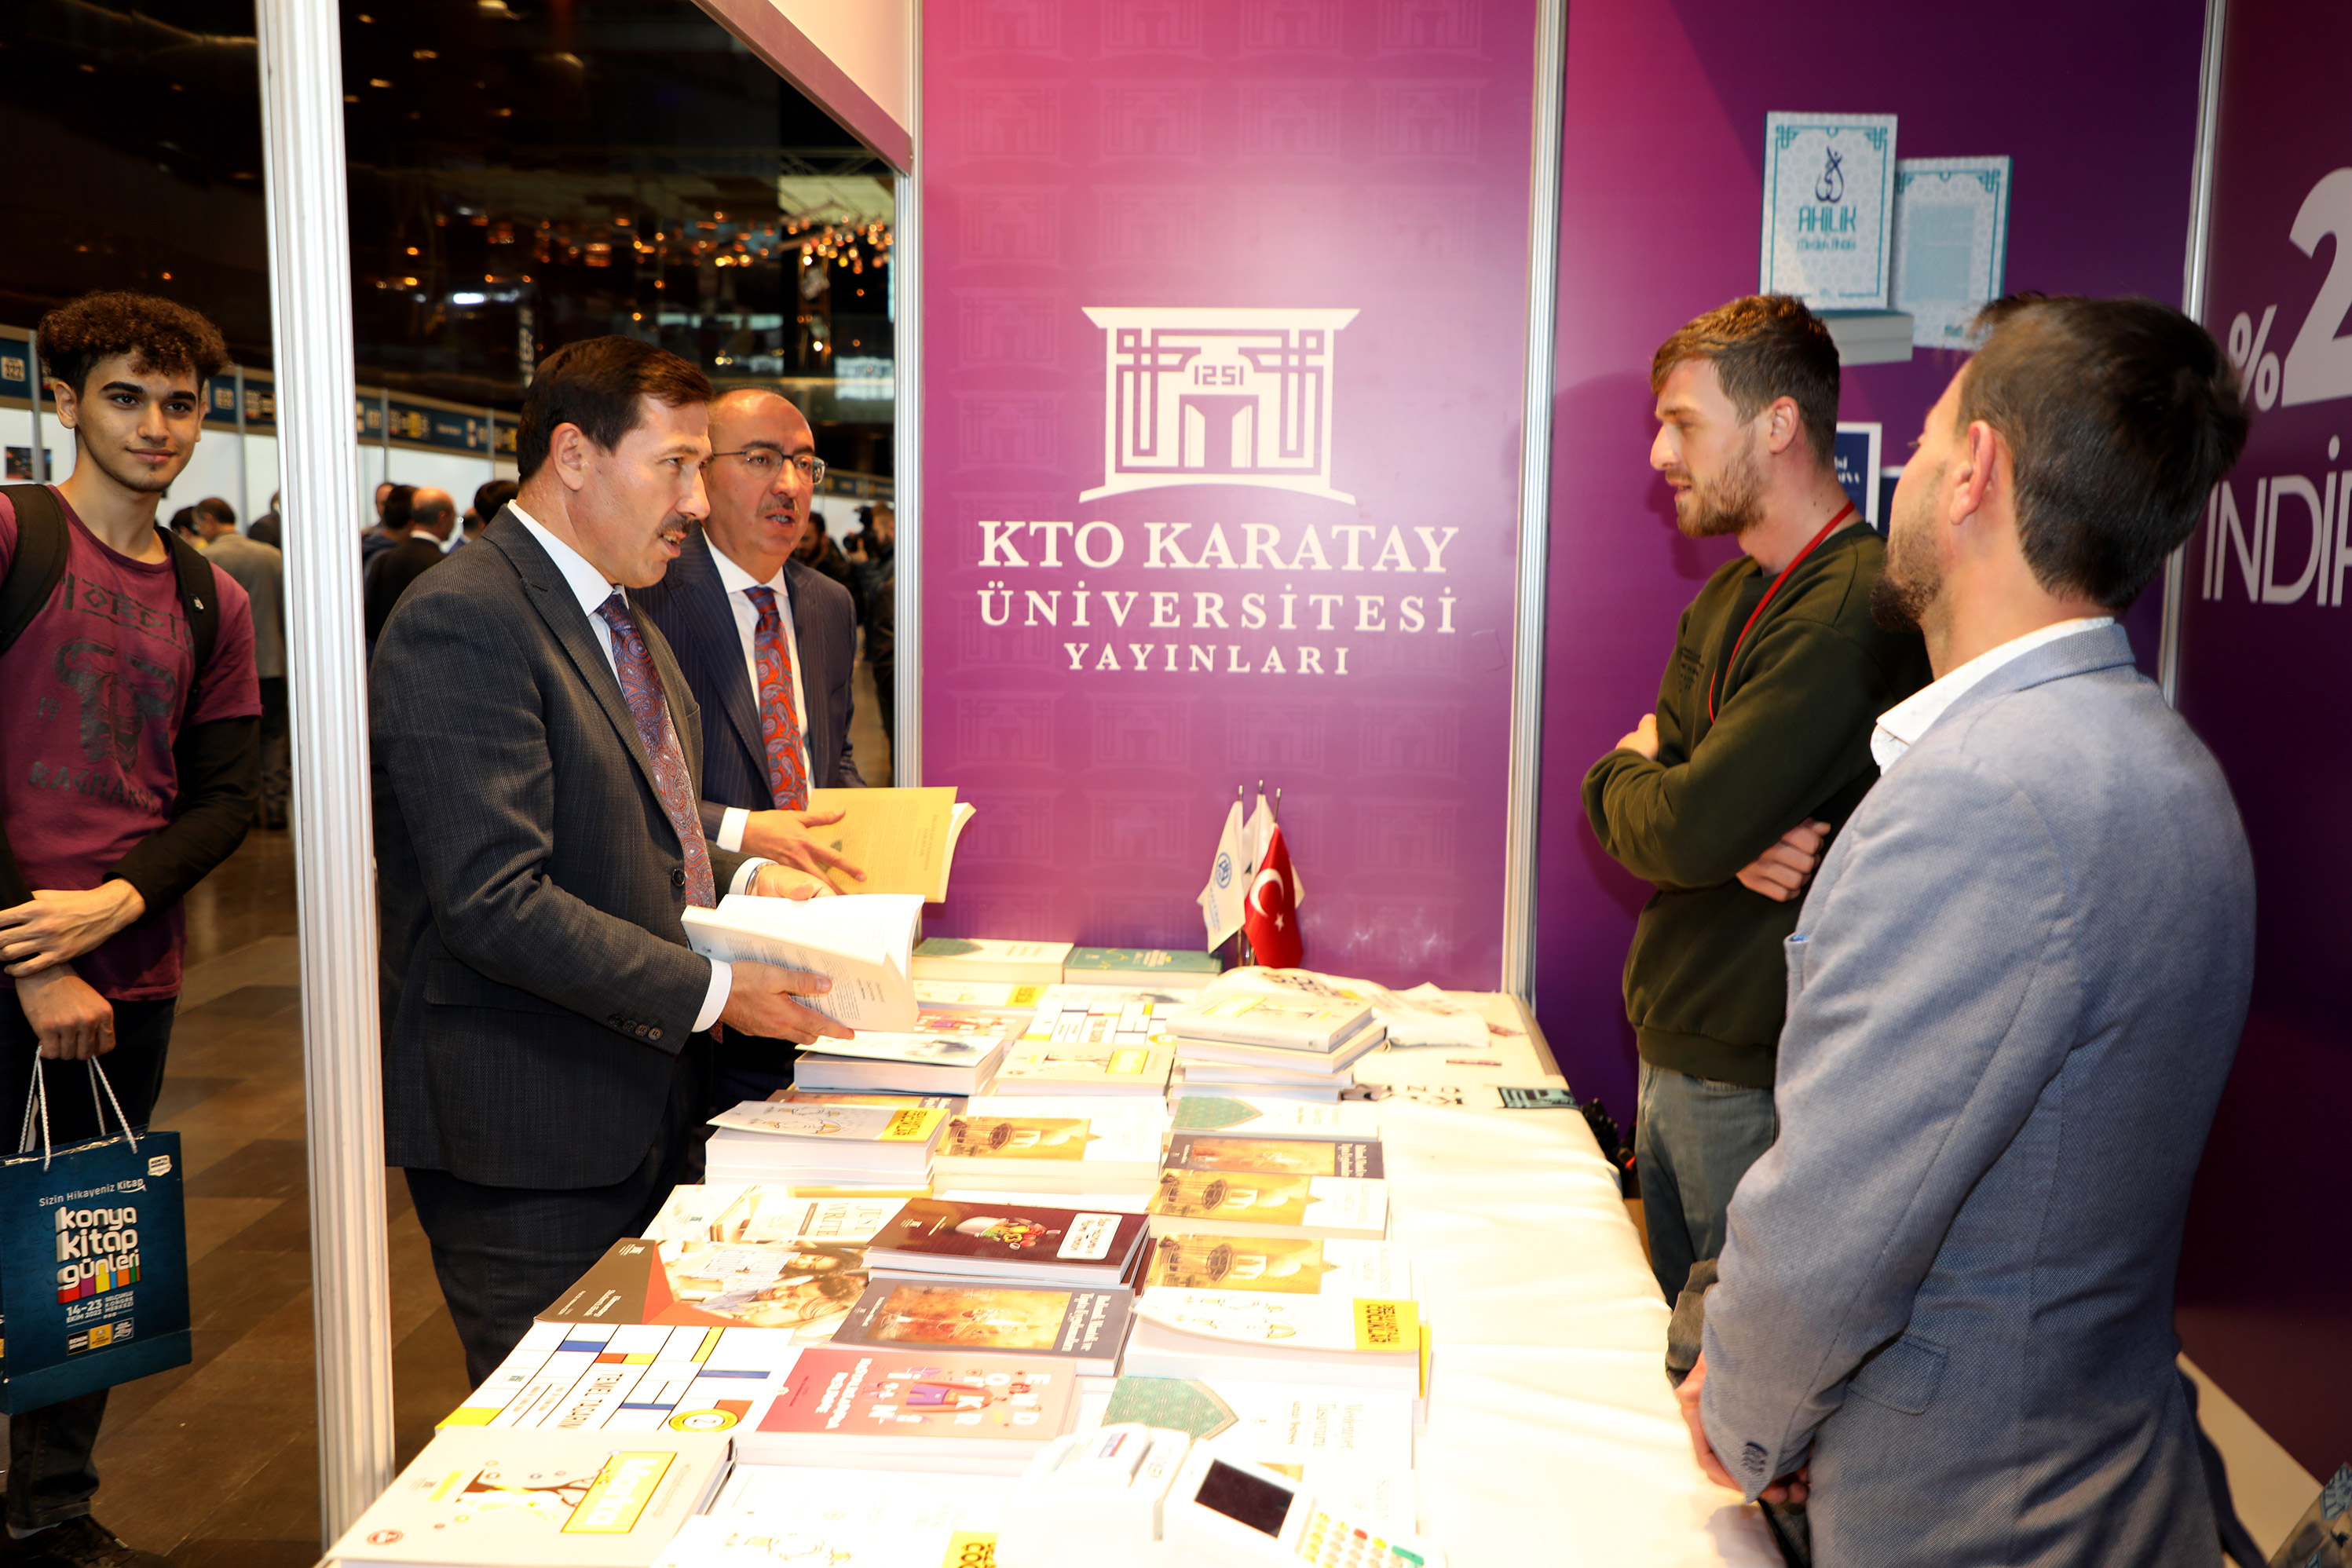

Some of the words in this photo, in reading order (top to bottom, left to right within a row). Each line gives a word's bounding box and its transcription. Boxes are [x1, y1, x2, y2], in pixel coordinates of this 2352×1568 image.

[1194, 364, 1245, 386] 1251
[977, 520, 1125, 568] KTO
[1143, 521, 1460, 572] KARATAY
[976, 579, 1458, 634] ÜNİVERSİTESİ
[1063, 642, 1349, 675] YAYINLARI
[39, 1195, 64, 1207] Sizin
[67, 1184, 115, 1200] Hikayeniz
[117, 1178, 144, 1191] Kitap
[57, 1206, 137, 1231] konya
[817, 1202, 849, 1237] WRITE
[855, 1205, 883, 1234] JUST
[58, 1229, 140, 1261] kitap
[58, 1249, 141, 1290] günleri
[66, 1299, 103, 1318] 14-23
[585, 1372, 624, 1396] TEMEL
[584, 1457, 660, 1527] Marka
